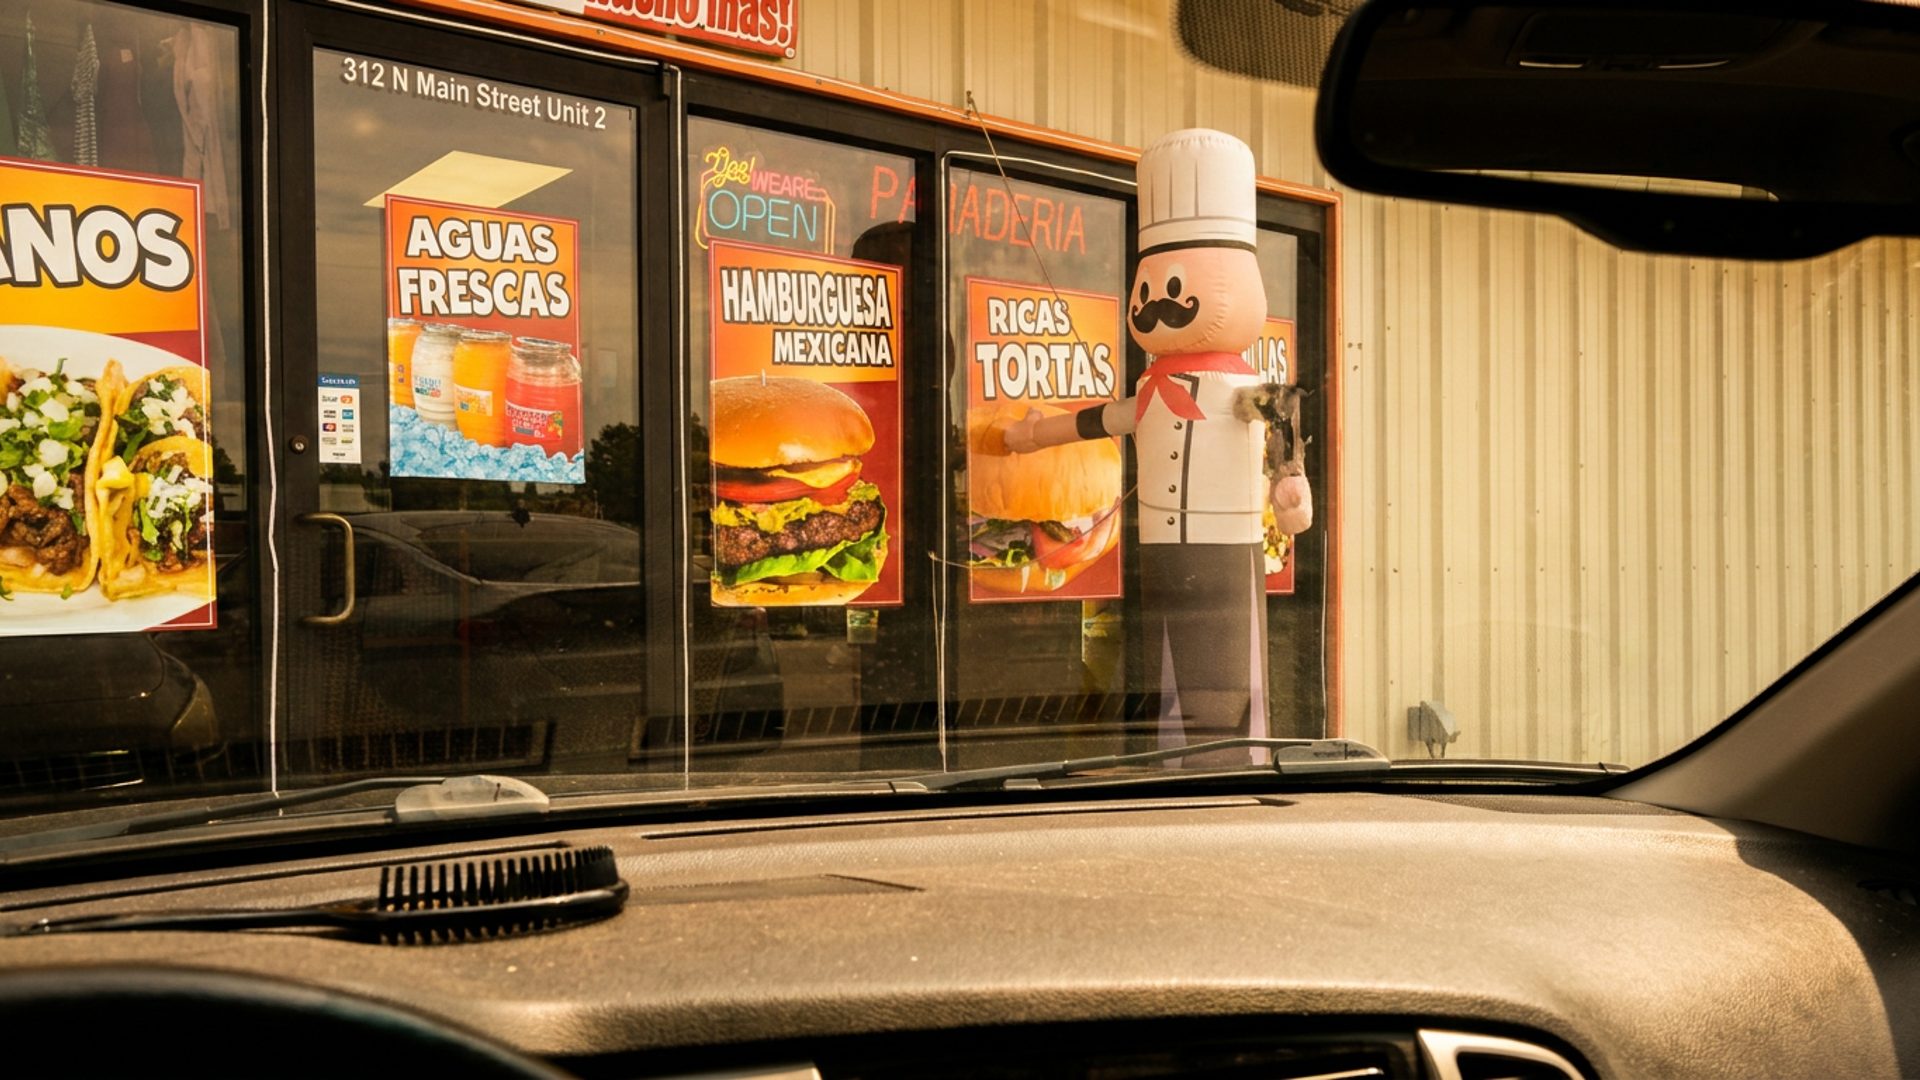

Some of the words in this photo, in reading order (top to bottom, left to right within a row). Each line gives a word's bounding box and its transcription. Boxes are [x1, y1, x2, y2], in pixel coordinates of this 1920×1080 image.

[343, 57, 385, 88] 312
[392, 66, 408, 92] N
[417, 71, 470, 103] Main
[476, 83, 541, 118] Street
[547, 97, 589, 127] Unit
[594, 106, 606, 129] 2
[708, 189, 818, 242] OPEN
[869, 165, 1087, 256] PAADERIA
[0, 202, 194, 293] NOS
[404, 215, 558, 264] AGUAS
[397, 267, 571, 318] FRESCAS
[719, 266, 893, 329] HAMBURGUESA
[987, 296, 1072, 336] RICAS
[772, 328, 895, 367] MEXICANA
[974, 339, 1117, 401] TORTAS
